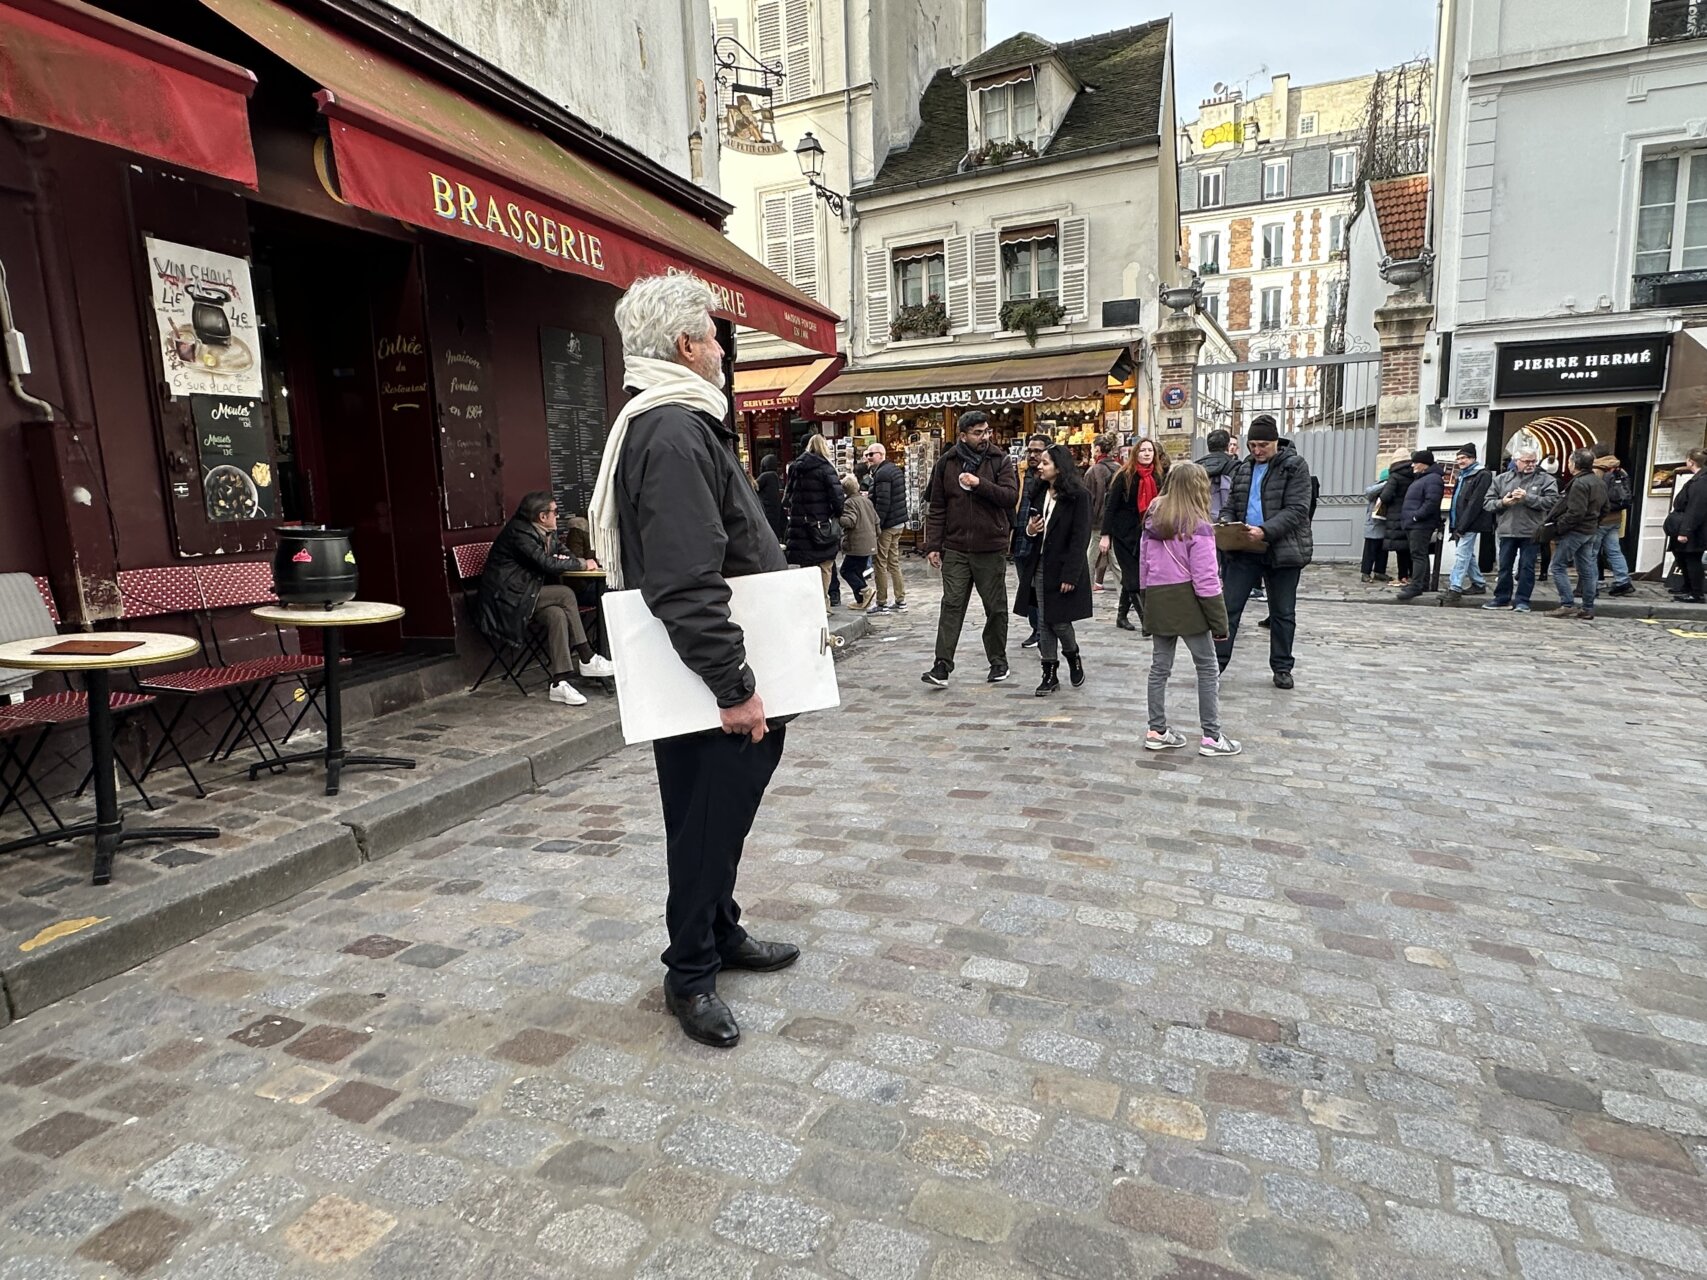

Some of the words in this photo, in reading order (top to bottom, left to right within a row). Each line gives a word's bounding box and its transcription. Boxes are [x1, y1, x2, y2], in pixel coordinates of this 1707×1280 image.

[428, 171, 605, 271] BRASSERIE
[153, 257, 186, 281] VIN
[377, 334, 423, 359] Entrée
[1513, 356, 1579, 371] PIERRE
[1585, 349, 1651, 367] HERMÉ
[1560, 371, 1598, 379] PARIS
[187, 382, 206, 392] SUR
[865, 389, 972, 408] MONTMARTRE
[975, 385, 1043, 401] VILLAGE
[211, 402, 250, 419] Moules
[743, 399, 775, 408] SERVICE
